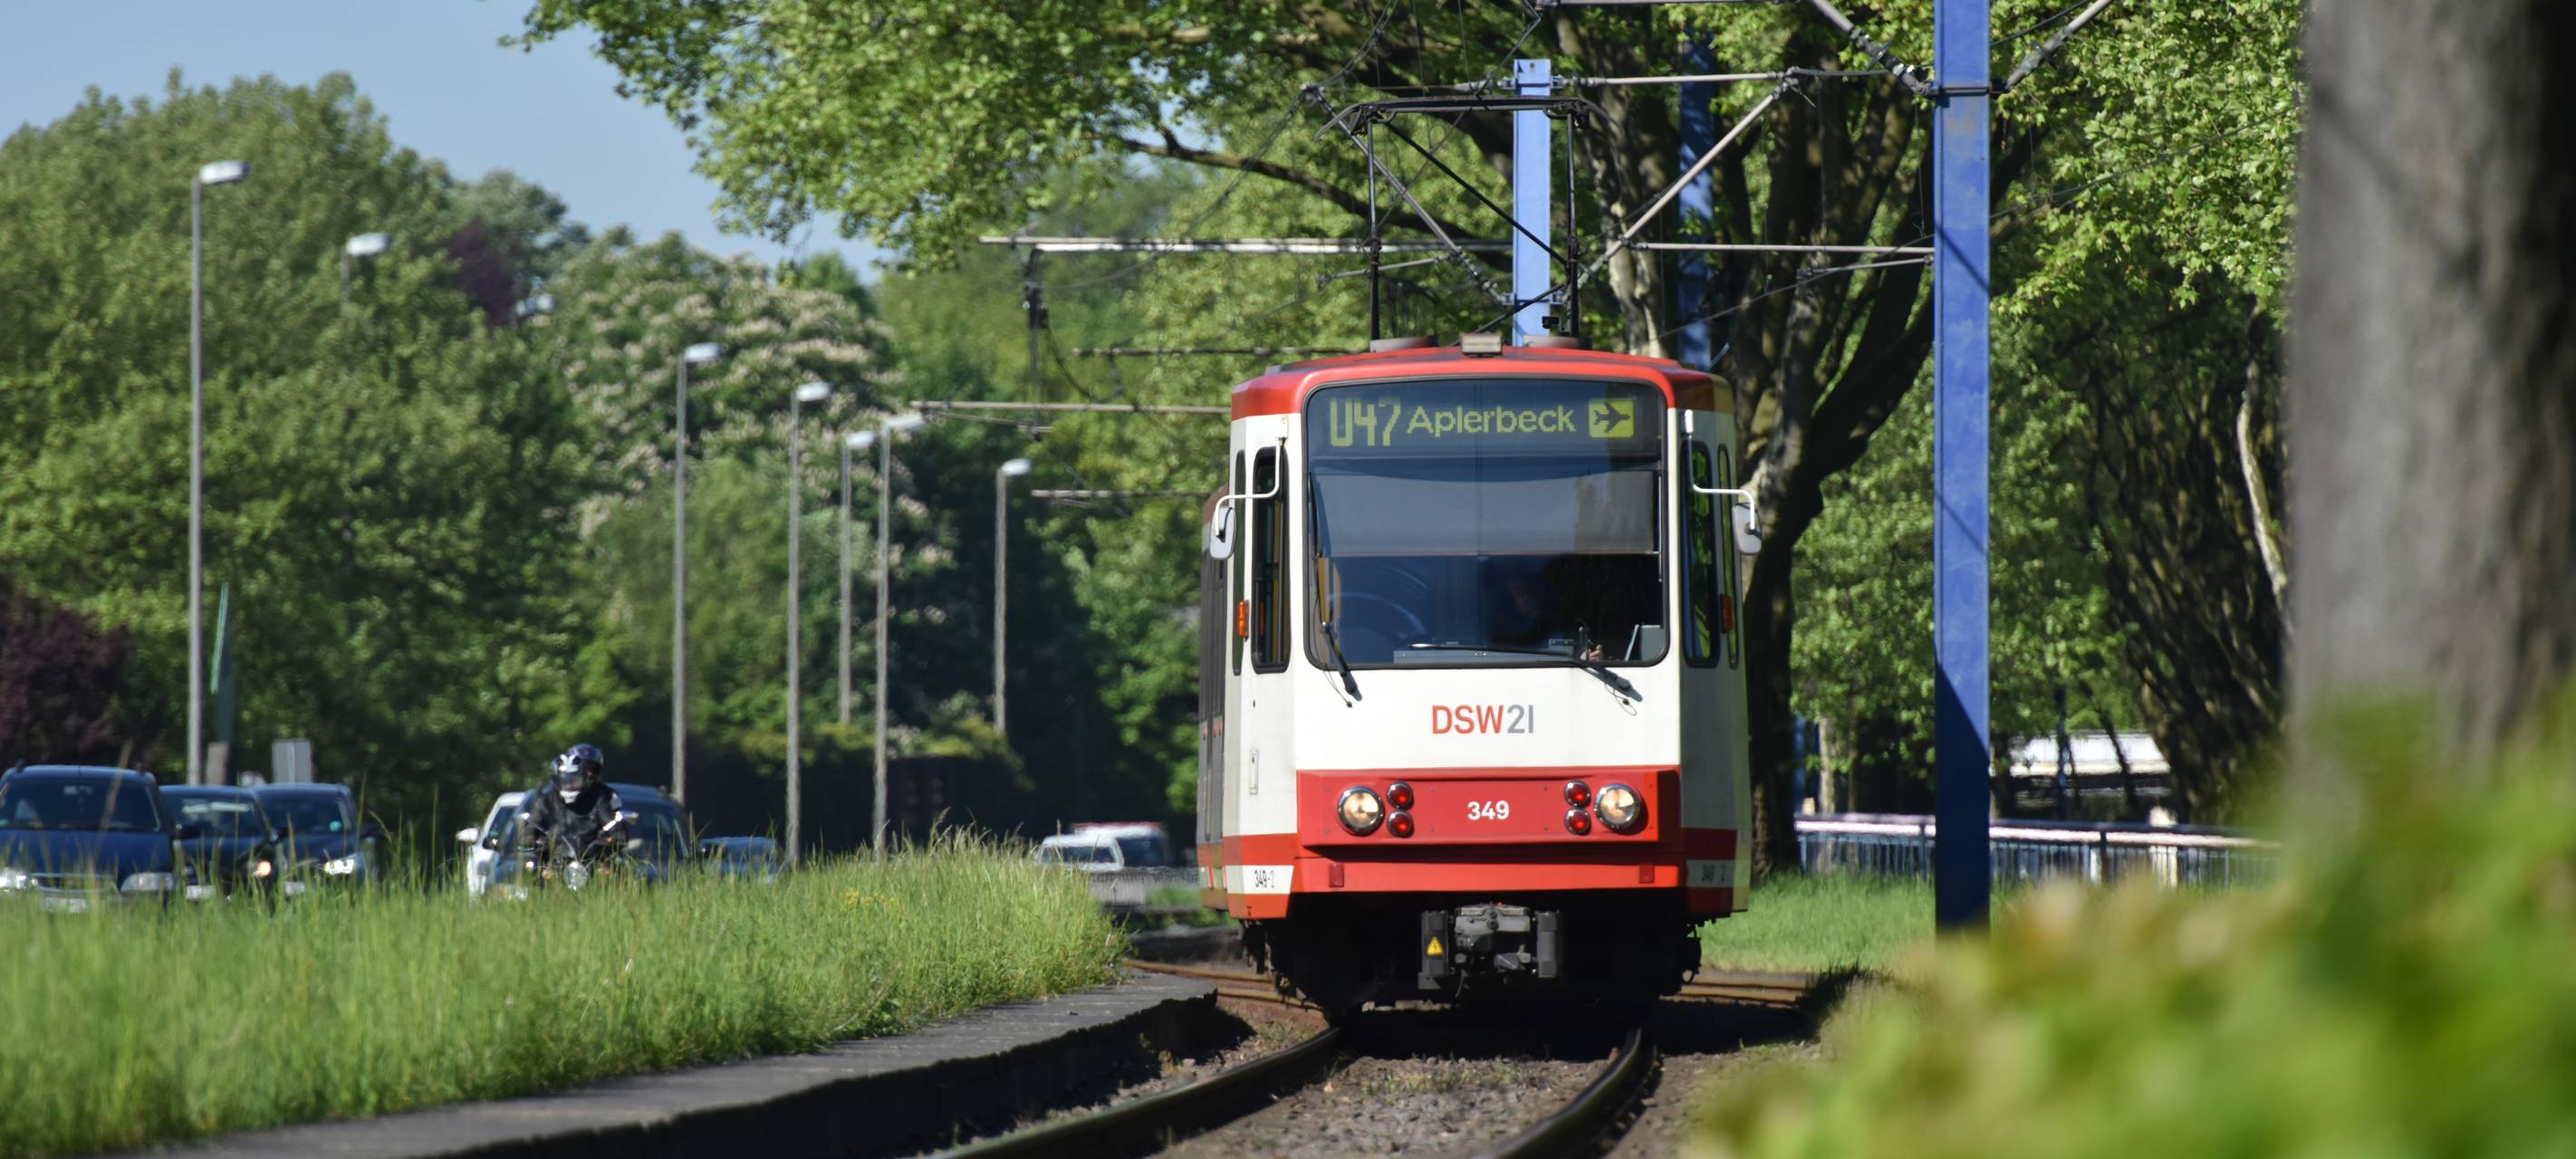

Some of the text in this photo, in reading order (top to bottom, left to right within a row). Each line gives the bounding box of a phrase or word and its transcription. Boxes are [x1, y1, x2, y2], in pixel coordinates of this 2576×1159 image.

[1330, 397, 1577, 447] U47 Aplerbeck
[1466, 800, 1510, 821] 349
